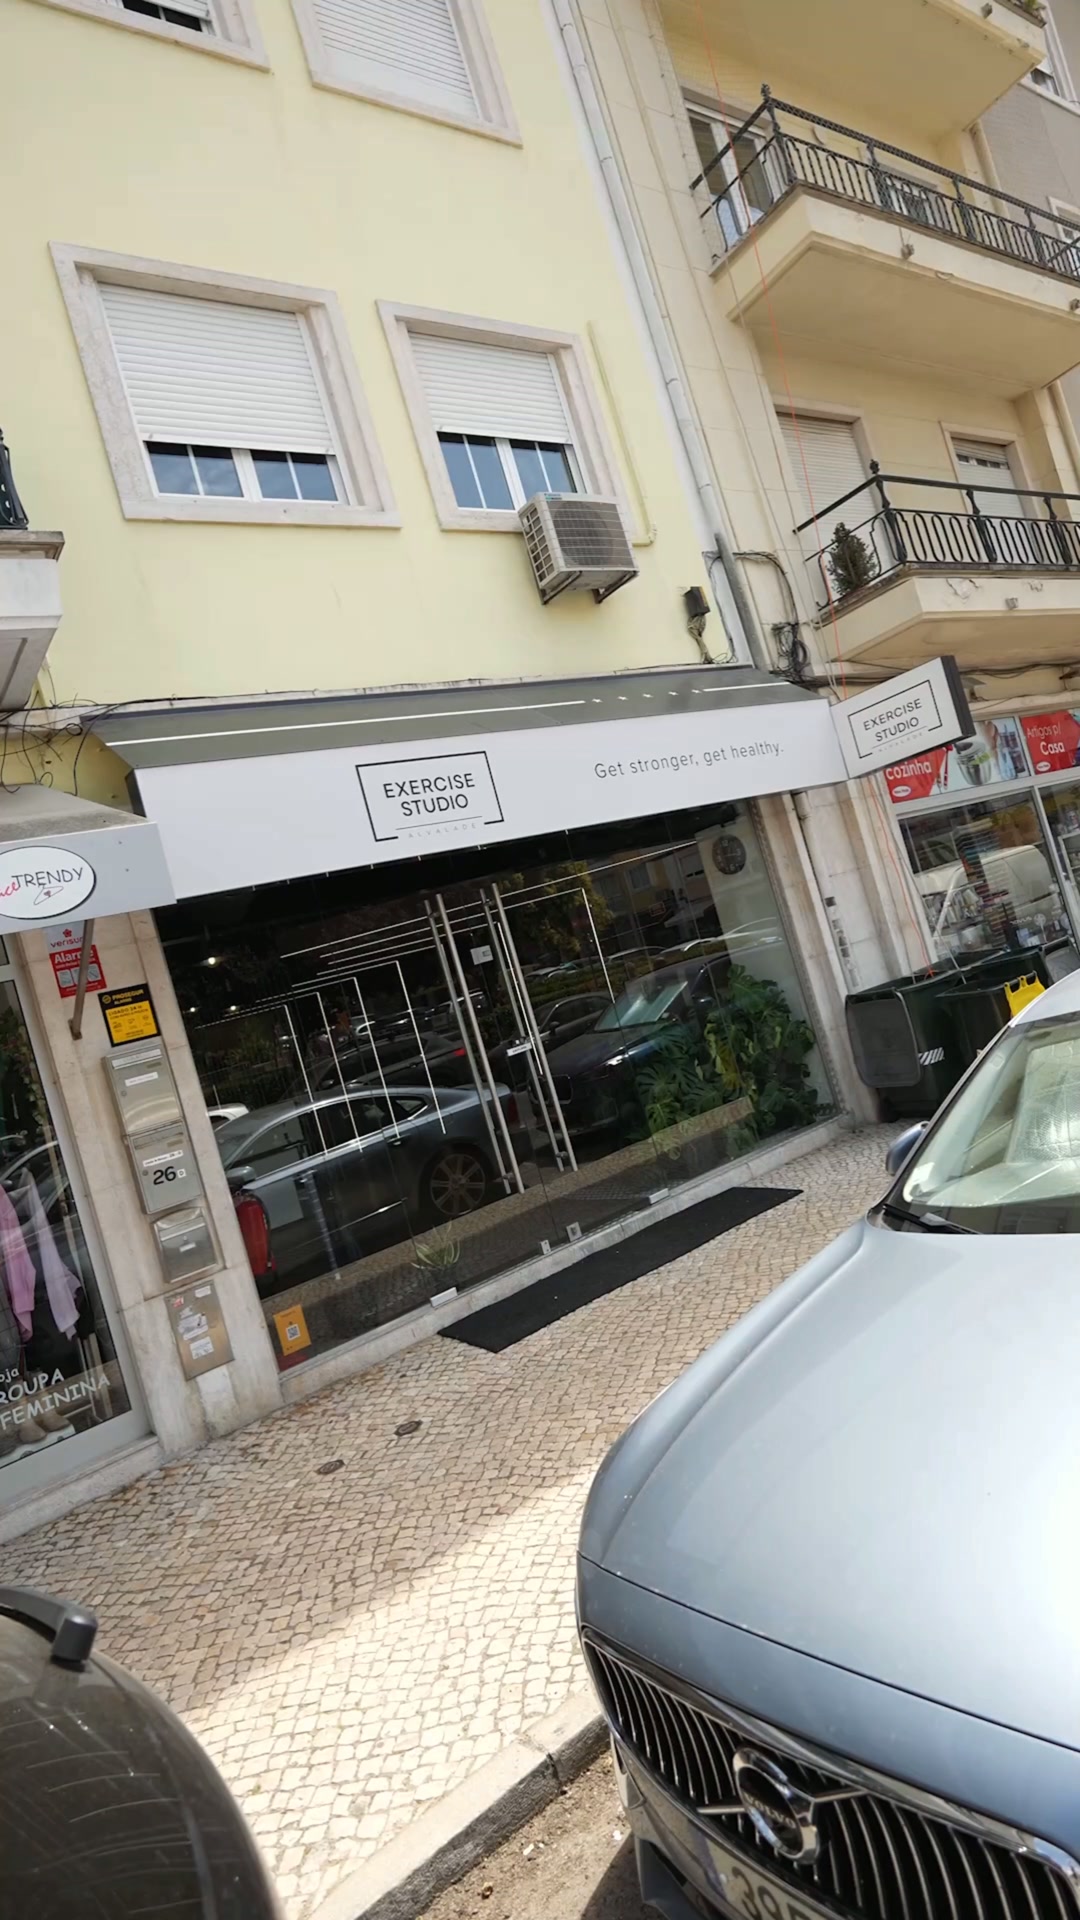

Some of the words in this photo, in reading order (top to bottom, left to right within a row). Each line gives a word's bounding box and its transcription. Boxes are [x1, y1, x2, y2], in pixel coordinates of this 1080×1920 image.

[863, 698, 922, 731] EXERCISE
[875, 717, 919, 742] STUDIO
[594, 762, 625, 778] Get
[629, 753, 699, 771] stronger,
[703, 747, 727, 766] get
[730, 741, 784, 757] healthy.
[1040, 741, 1066, 756] Casa
[383, 773, 475, 798] EXERCISE
[401, 794, 469, 816] STUDIO
[409, 823, 477, 838] ALVALADE
[11, 867, 83, 888] TRENDY
[50, 936, 84, 948] verisur
[54, 950, 94, 964] Alar
[153, 1166, 177, 1185] 26
[0, 1373, 111, 1431] FEMININA
[741, 1791, 797, 1829] VOLVO
